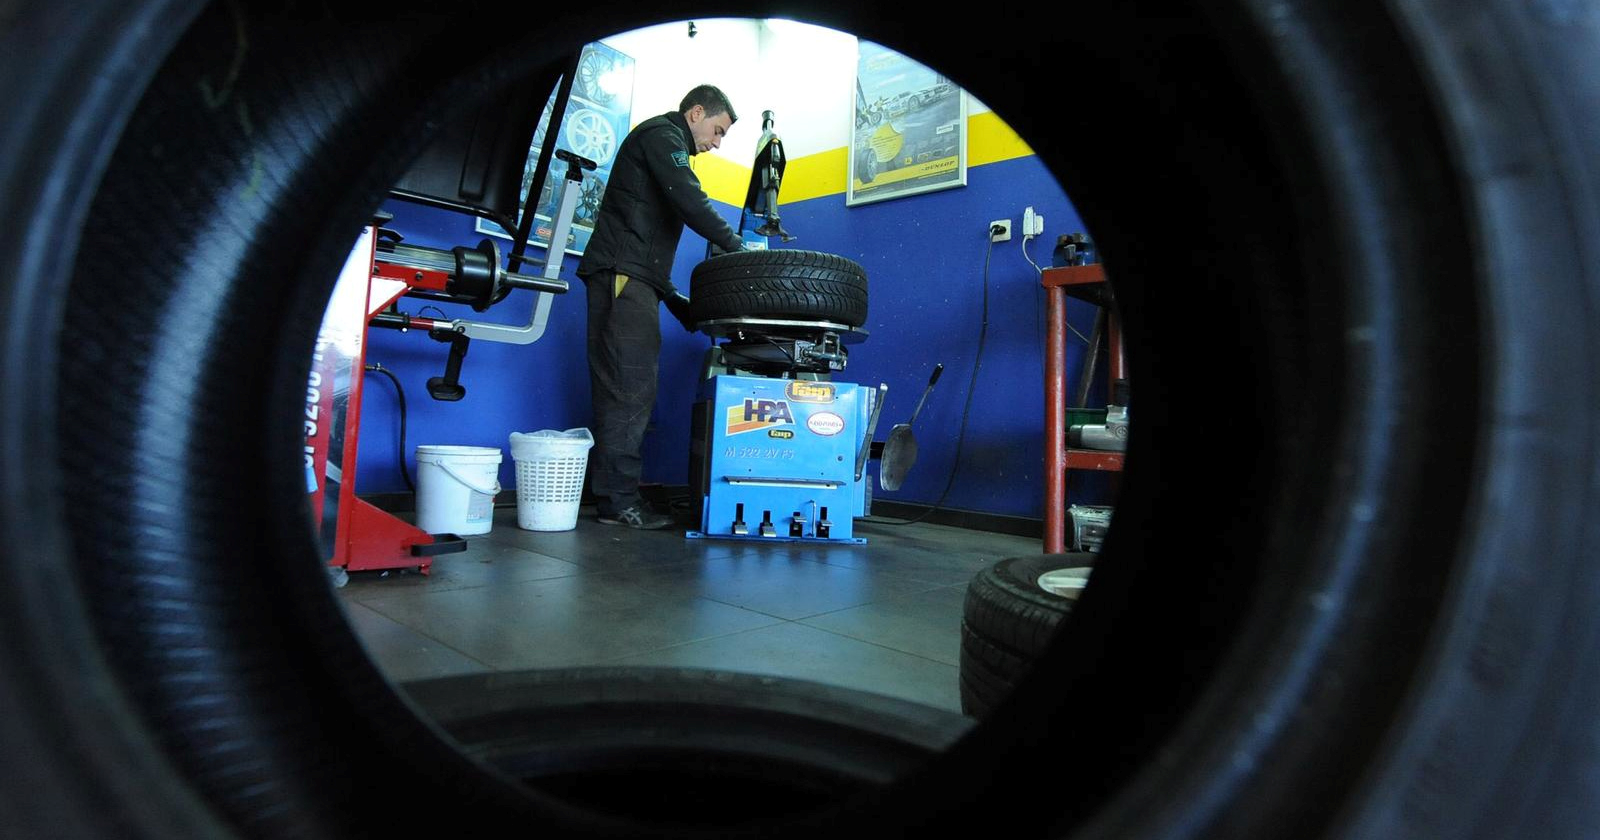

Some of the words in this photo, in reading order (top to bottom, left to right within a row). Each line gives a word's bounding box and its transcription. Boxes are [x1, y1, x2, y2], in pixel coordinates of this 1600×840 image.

[923, 160, 955, 171] DUNLOP
[744, 399, 793, 424] HPA
[725, 446, 736, 458] M
